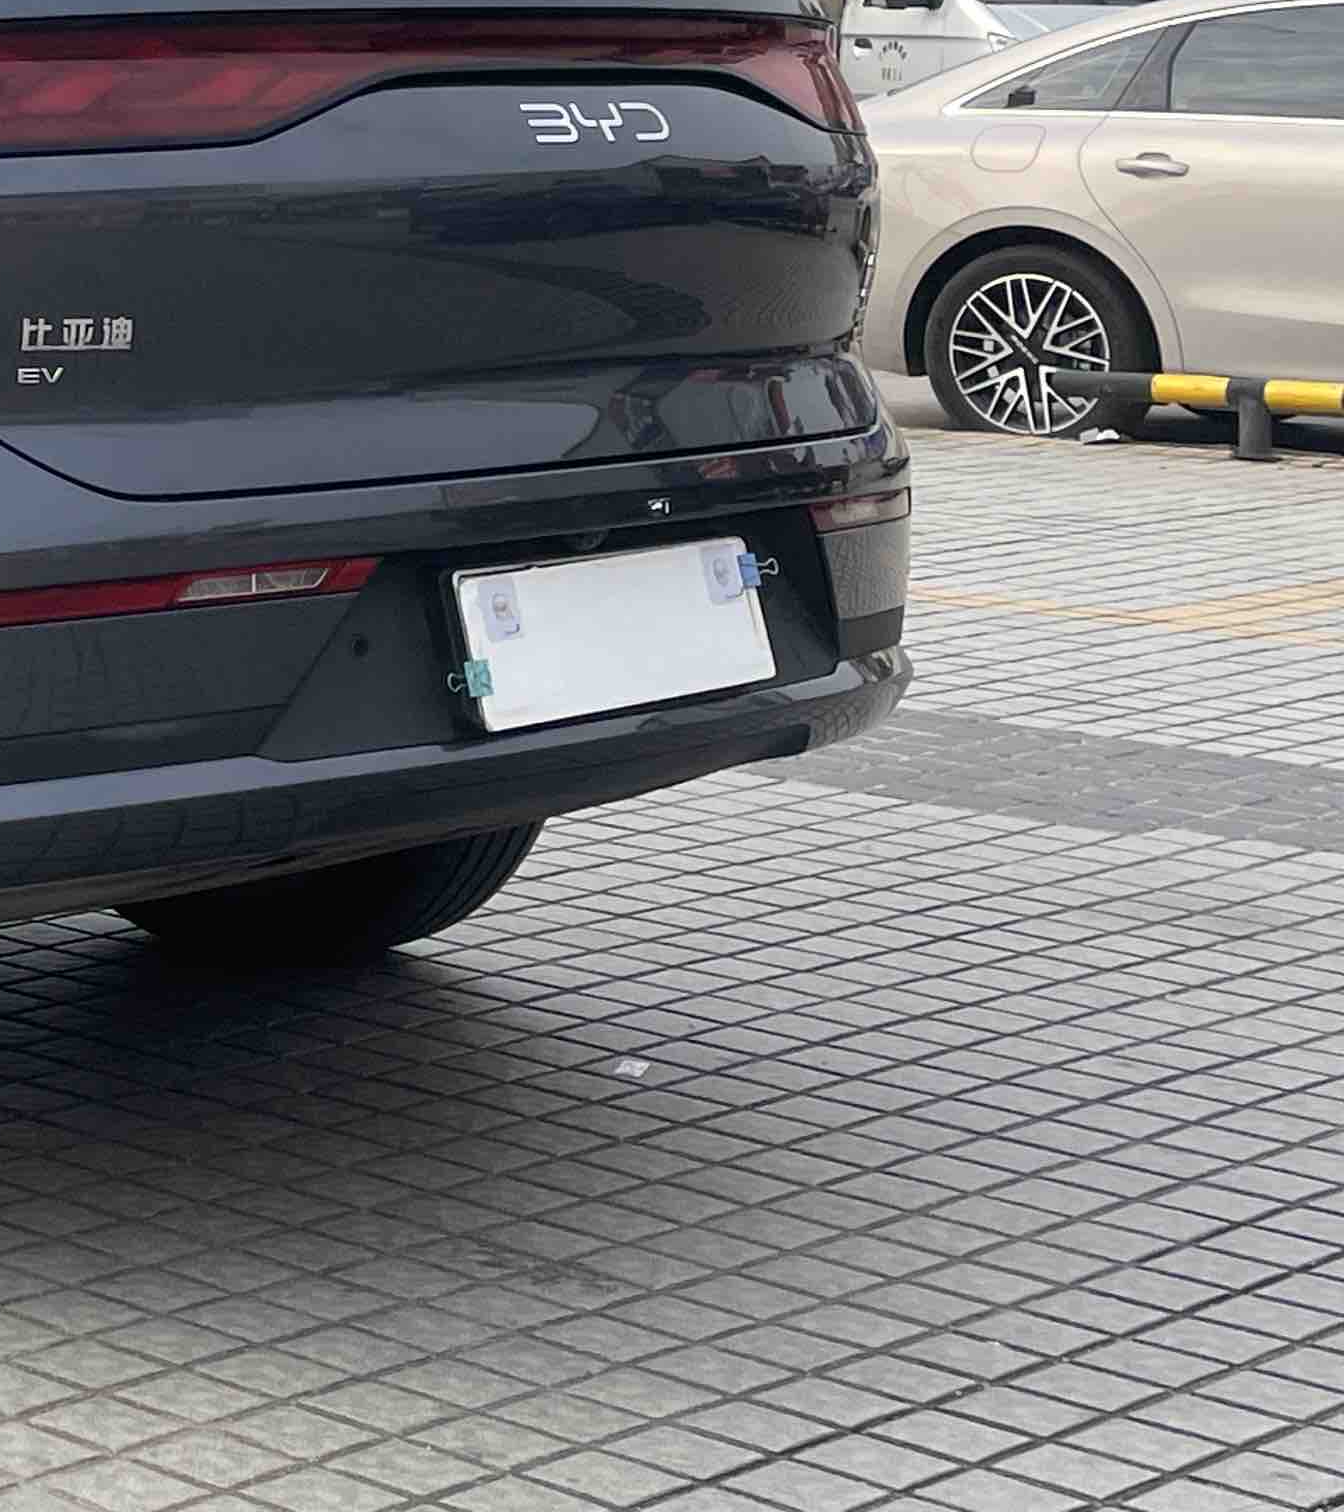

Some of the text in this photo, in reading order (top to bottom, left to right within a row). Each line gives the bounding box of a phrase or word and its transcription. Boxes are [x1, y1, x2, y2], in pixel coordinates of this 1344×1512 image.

[519, 102, 670, 143] BYD
[21, 316, 133, 351] 比亚迪
[17, 367, 64, 384] EV
